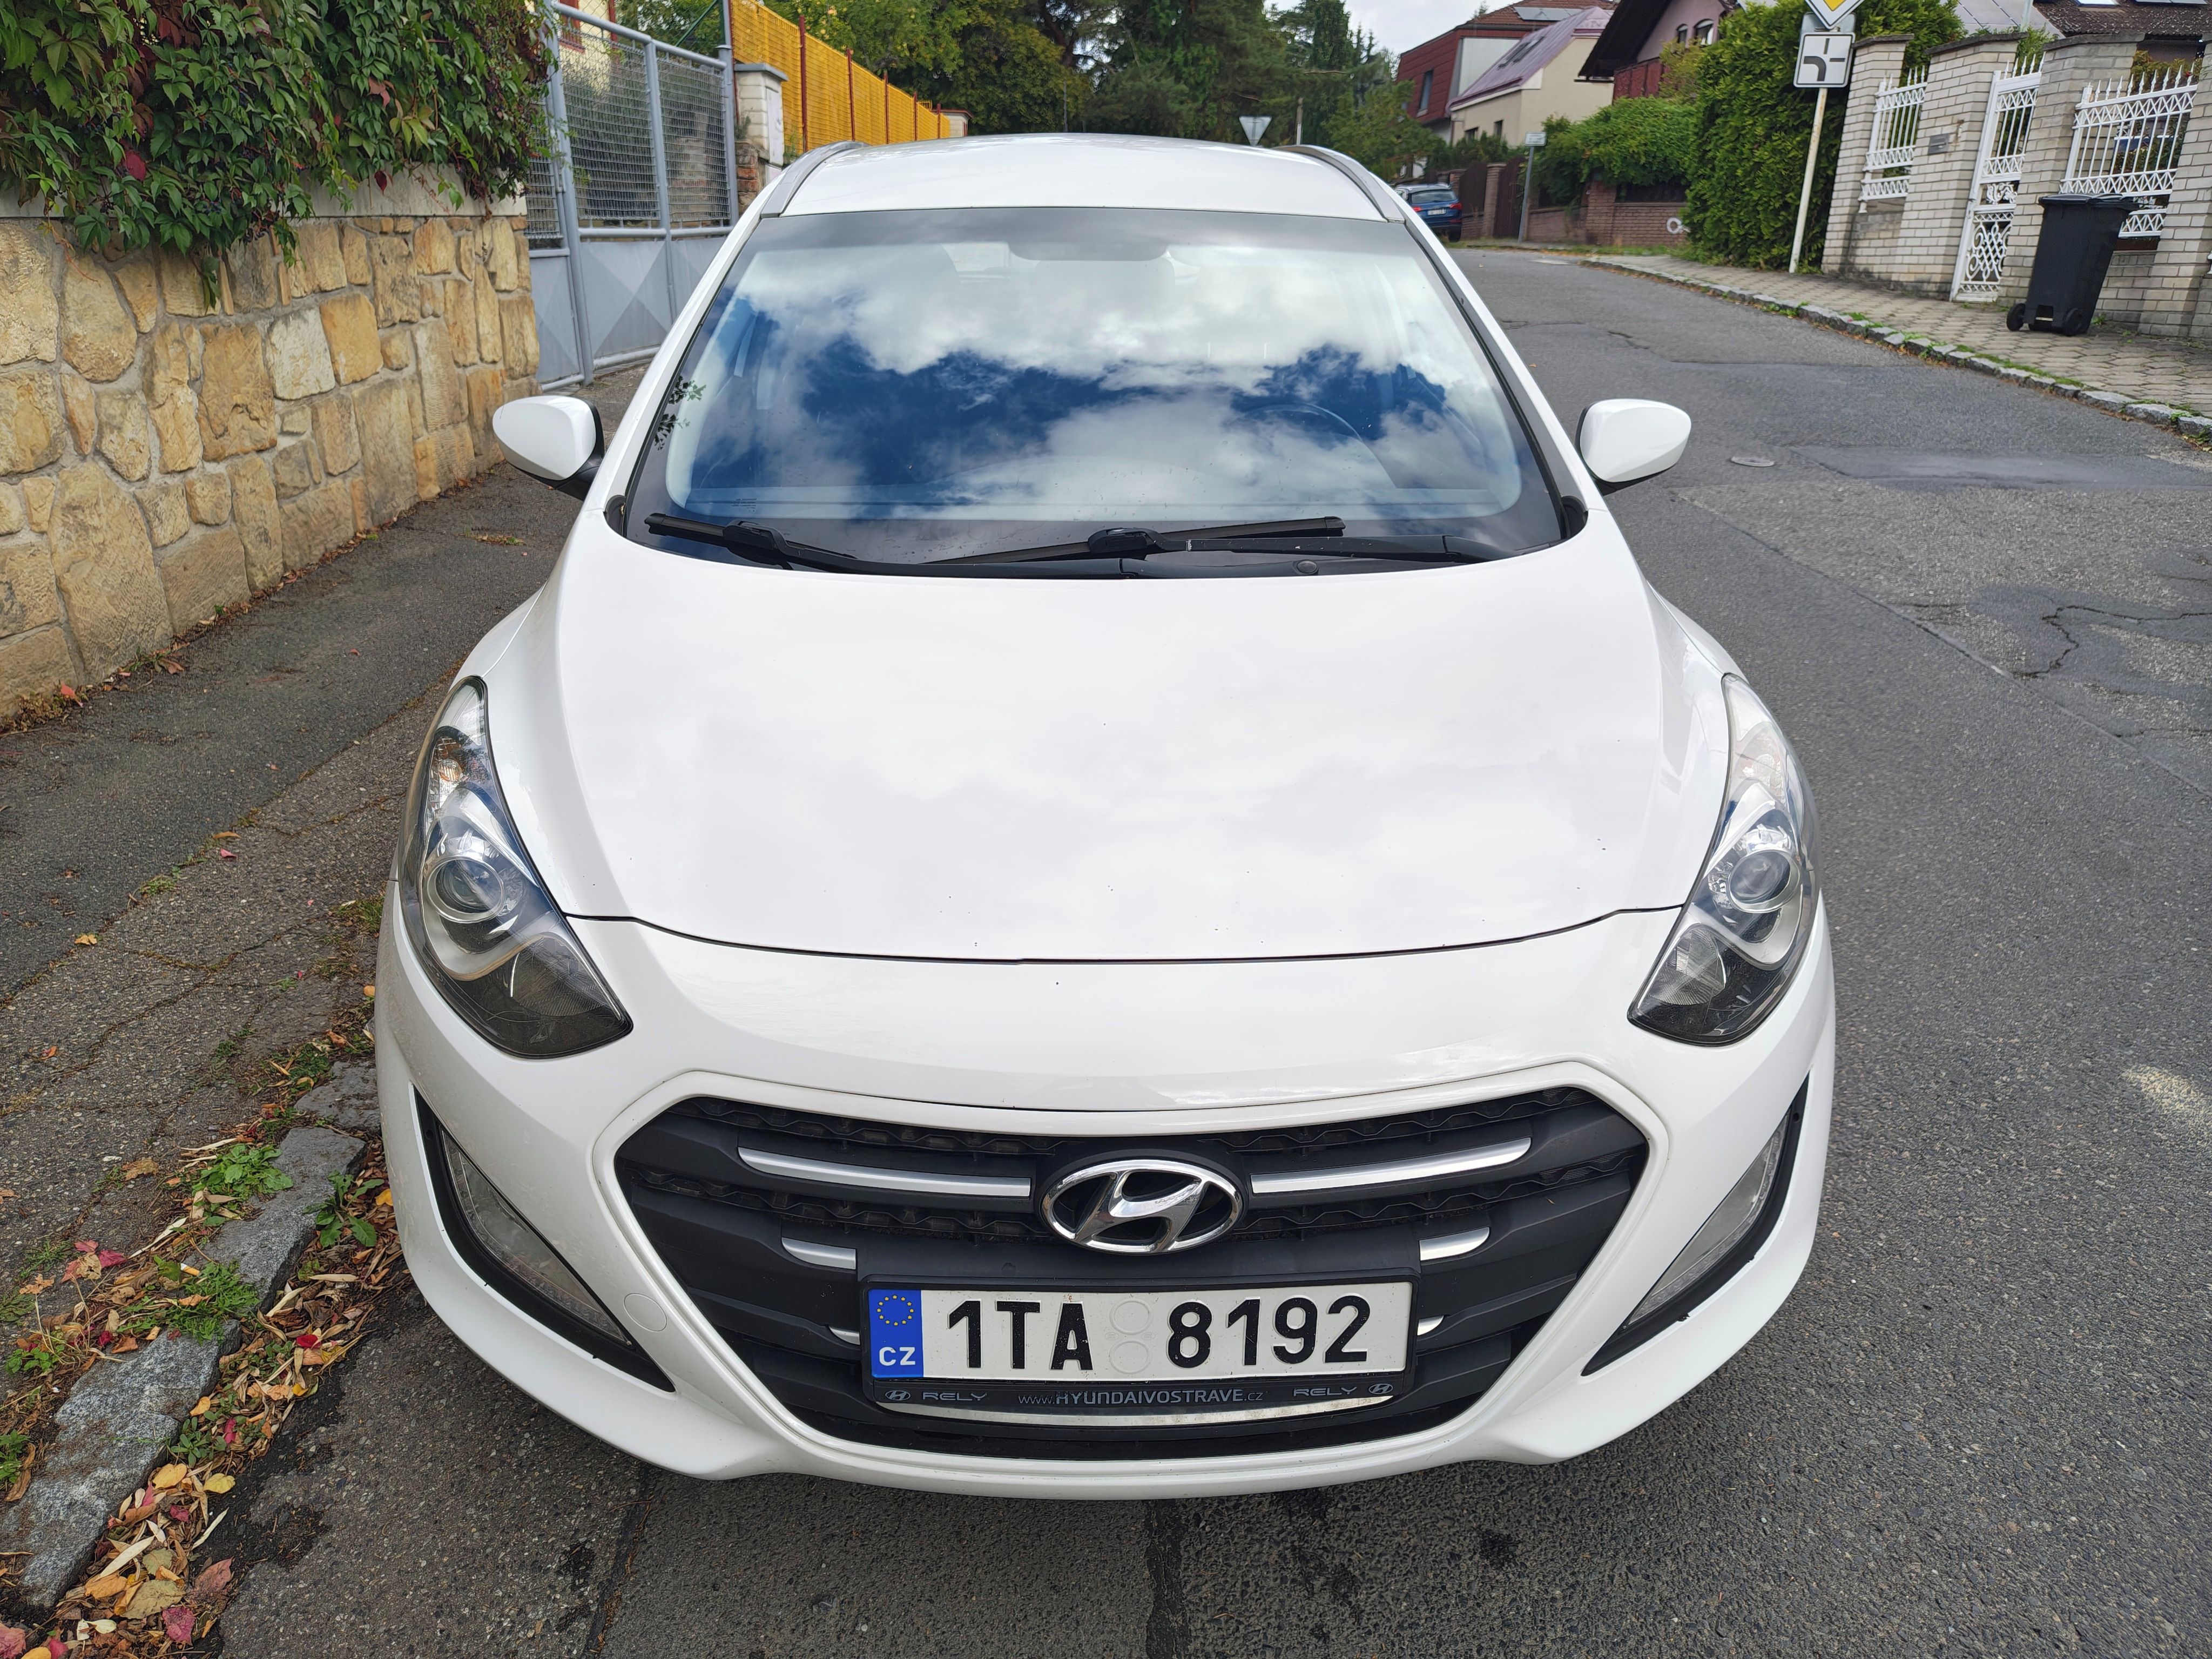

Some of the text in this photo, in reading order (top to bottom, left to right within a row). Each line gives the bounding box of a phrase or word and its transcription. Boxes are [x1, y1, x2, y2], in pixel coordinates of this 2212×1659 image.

[948, 1294, 1371, 1370] 1TA 8192
[879, 1347, 916, 1366] CZ
[922, 1392, 987, 1401] RELY
[1293, 1386, 1357, 1397] RELY
